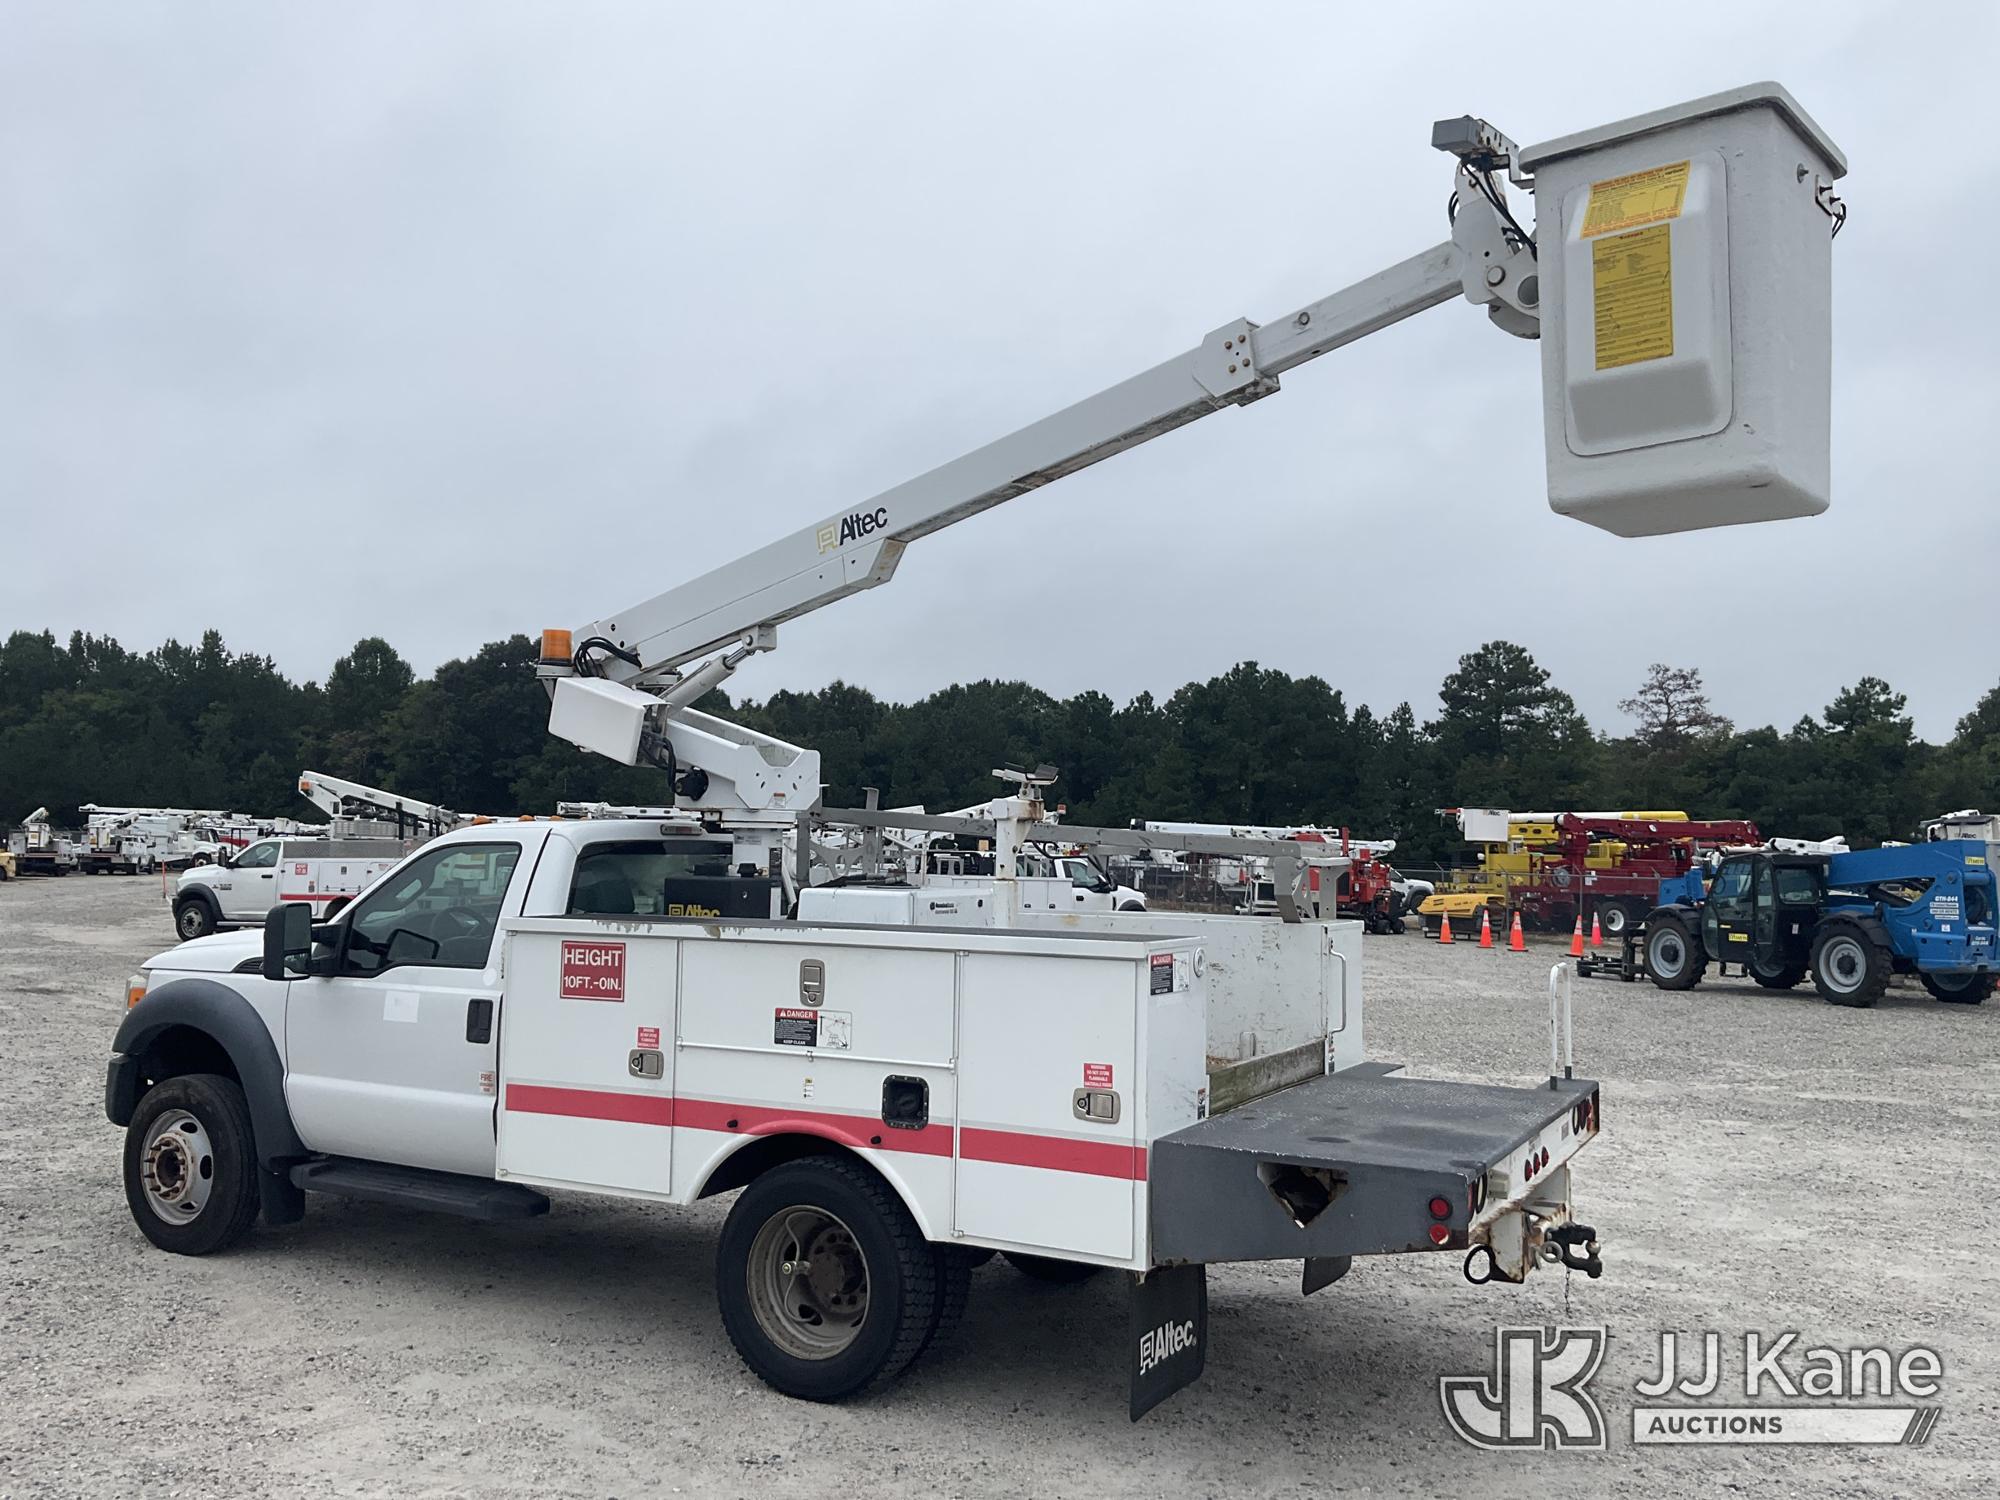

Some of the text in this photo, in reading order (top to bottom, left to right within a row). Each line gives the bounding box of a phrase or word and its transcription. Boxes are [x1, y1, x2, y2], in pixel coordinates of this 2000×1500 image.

[839, 507, 888, 546] Altec
[564, 948, 622, 967] HEIGHT
[786, 1010, 814, 1019] DANGER
[480, 1073, 493, 1081] FIRE
[1154, 1320, 1194, 1365] Altec
